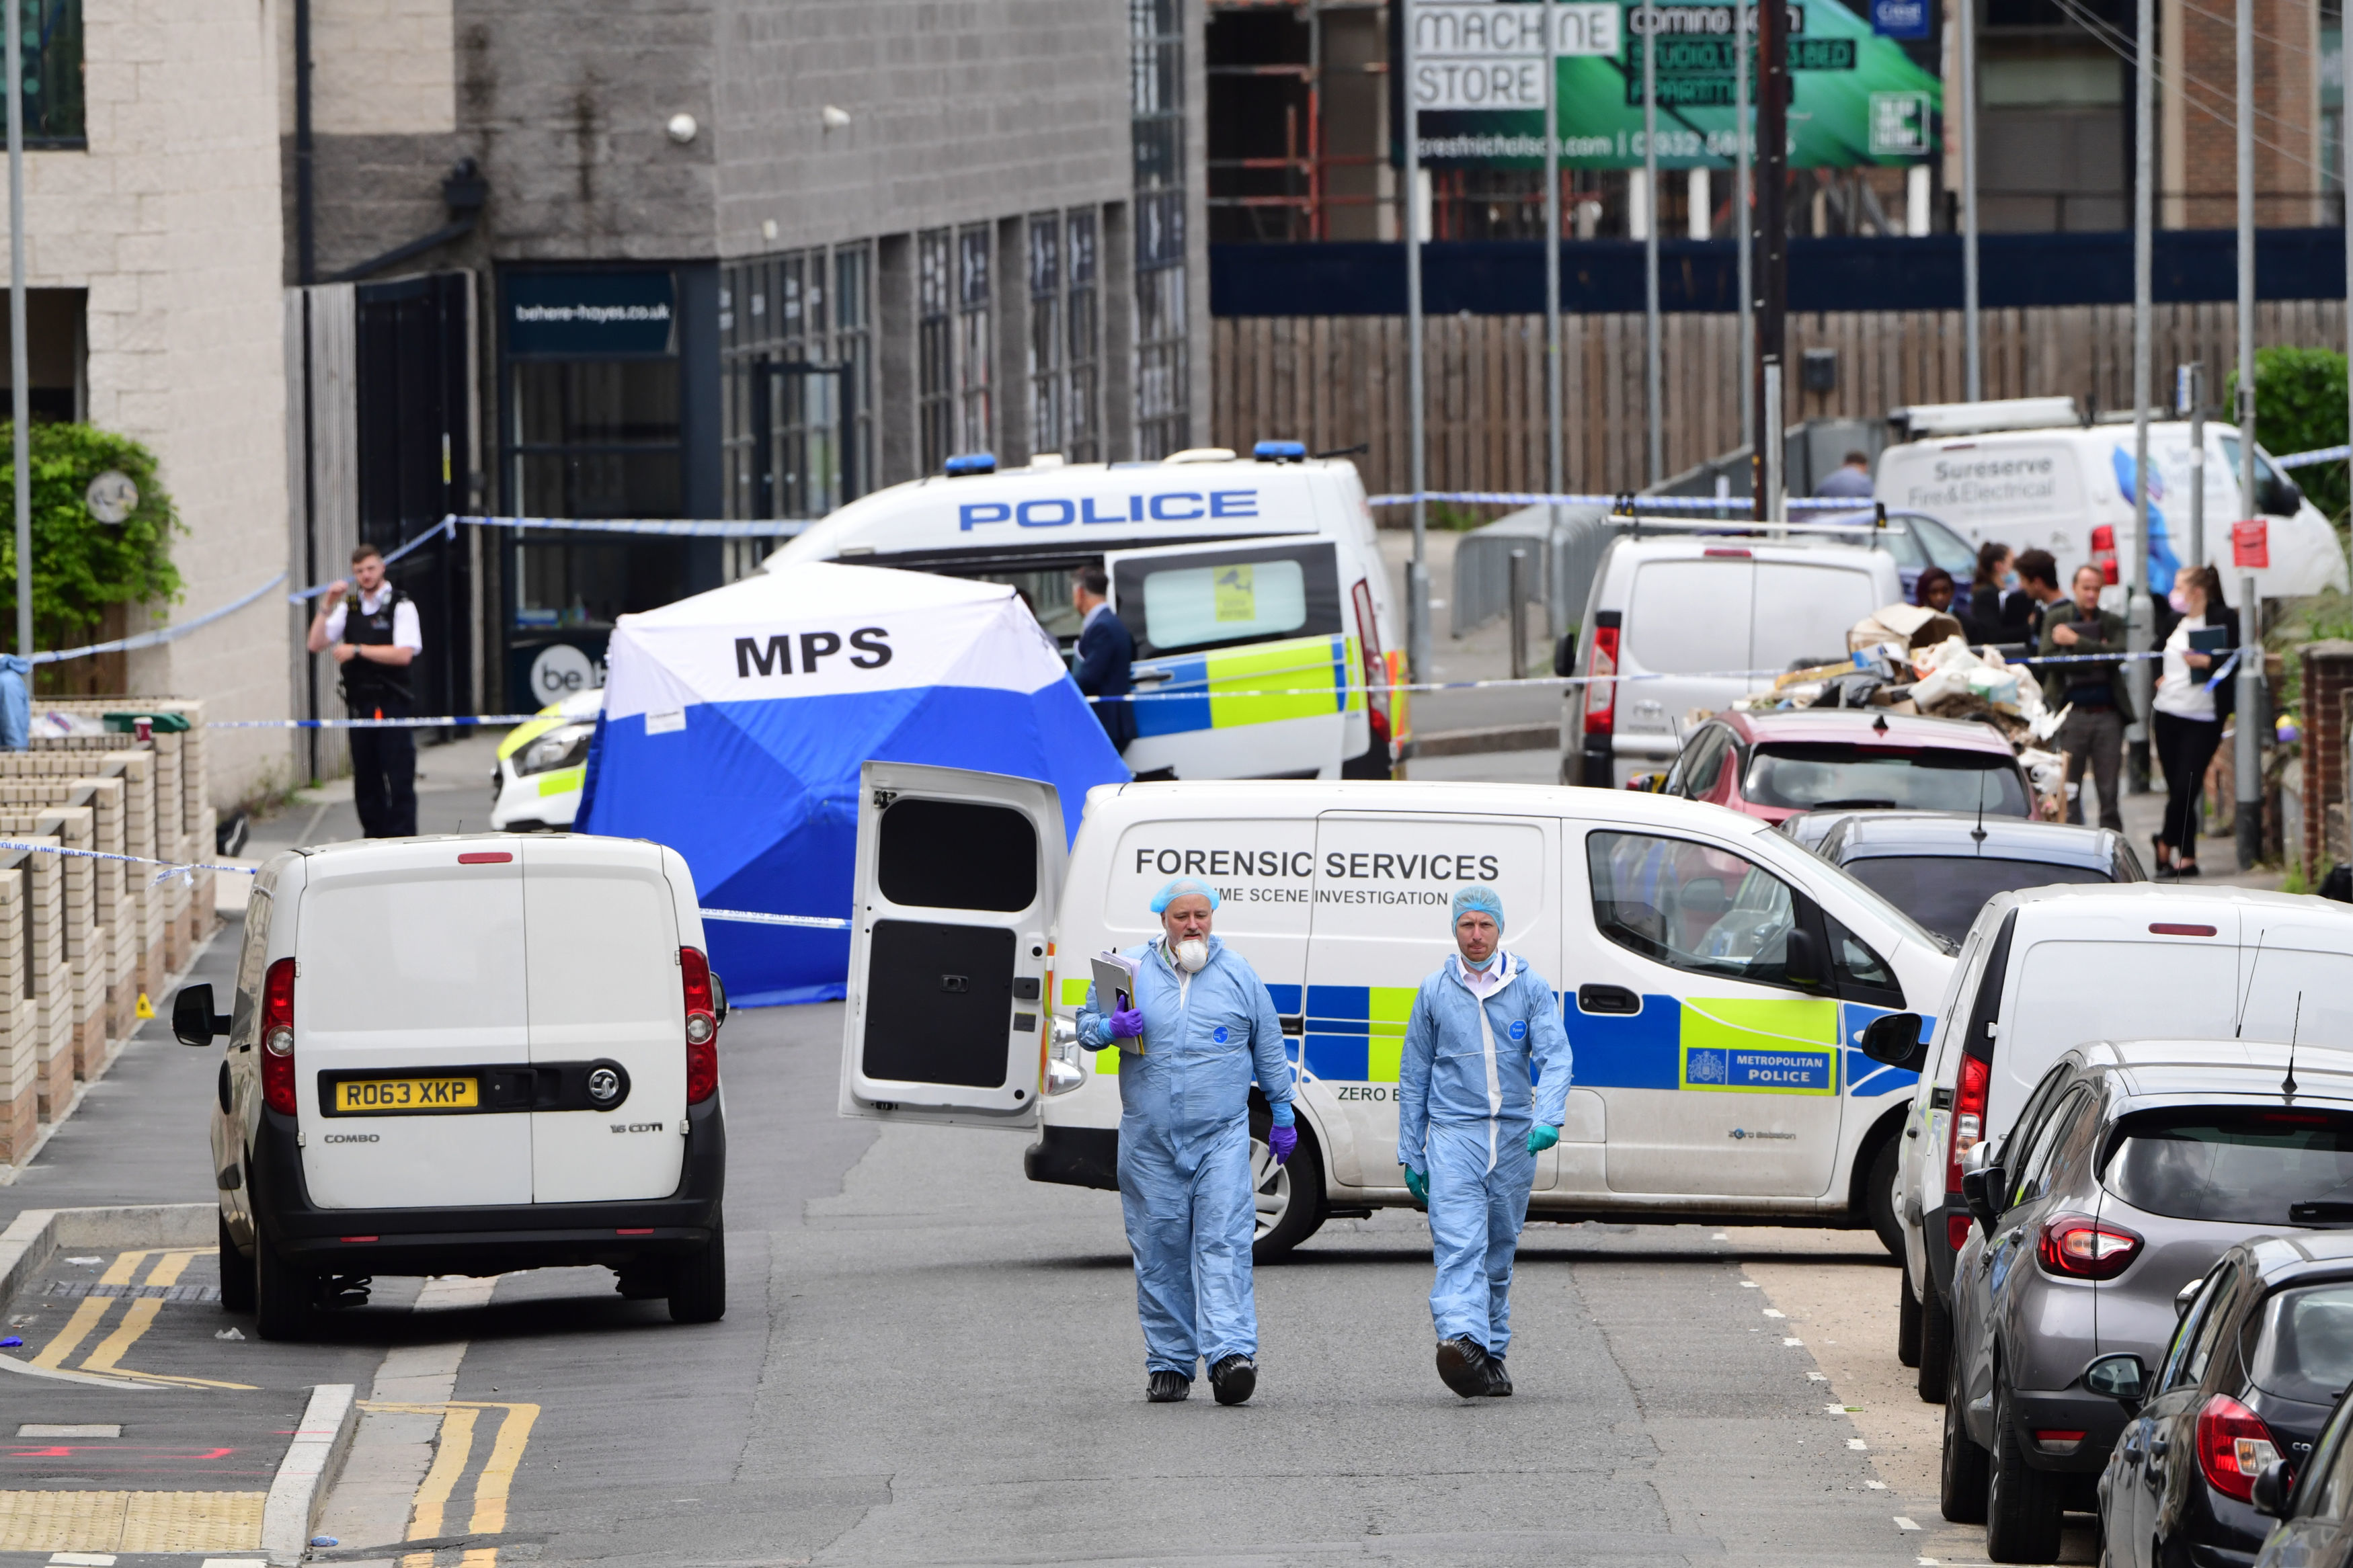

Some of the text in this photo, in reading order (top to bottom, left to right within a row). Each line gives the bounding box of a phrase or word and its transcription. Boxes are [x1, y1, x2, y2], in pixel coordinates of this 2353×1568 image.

[1415, 10, 1612, 50] MACHNE
[1414, 65, 1539, 104] STORE
[1934, 457, 2055, 483] Sureserve
[959, 489, 1259, 531] POLICE
[735, 627, 893, 678] MPS
[1136, 848, 1501, 881] FORENSIC SERVICES
[1249, 887, 1309, 903] SCENE
[1314, 890, 1448, 905] INVESTIGATION
[1737, 1055, 1823, 1067] METROPOLITAN
[1748, 1069, 1810, 1082] POLICE
[346, 1081, 467, 1106] RO63 XKP
[1338, 1086, 1386, 1102] ZERO
[324, 1134, 381, 1144] COMBO
